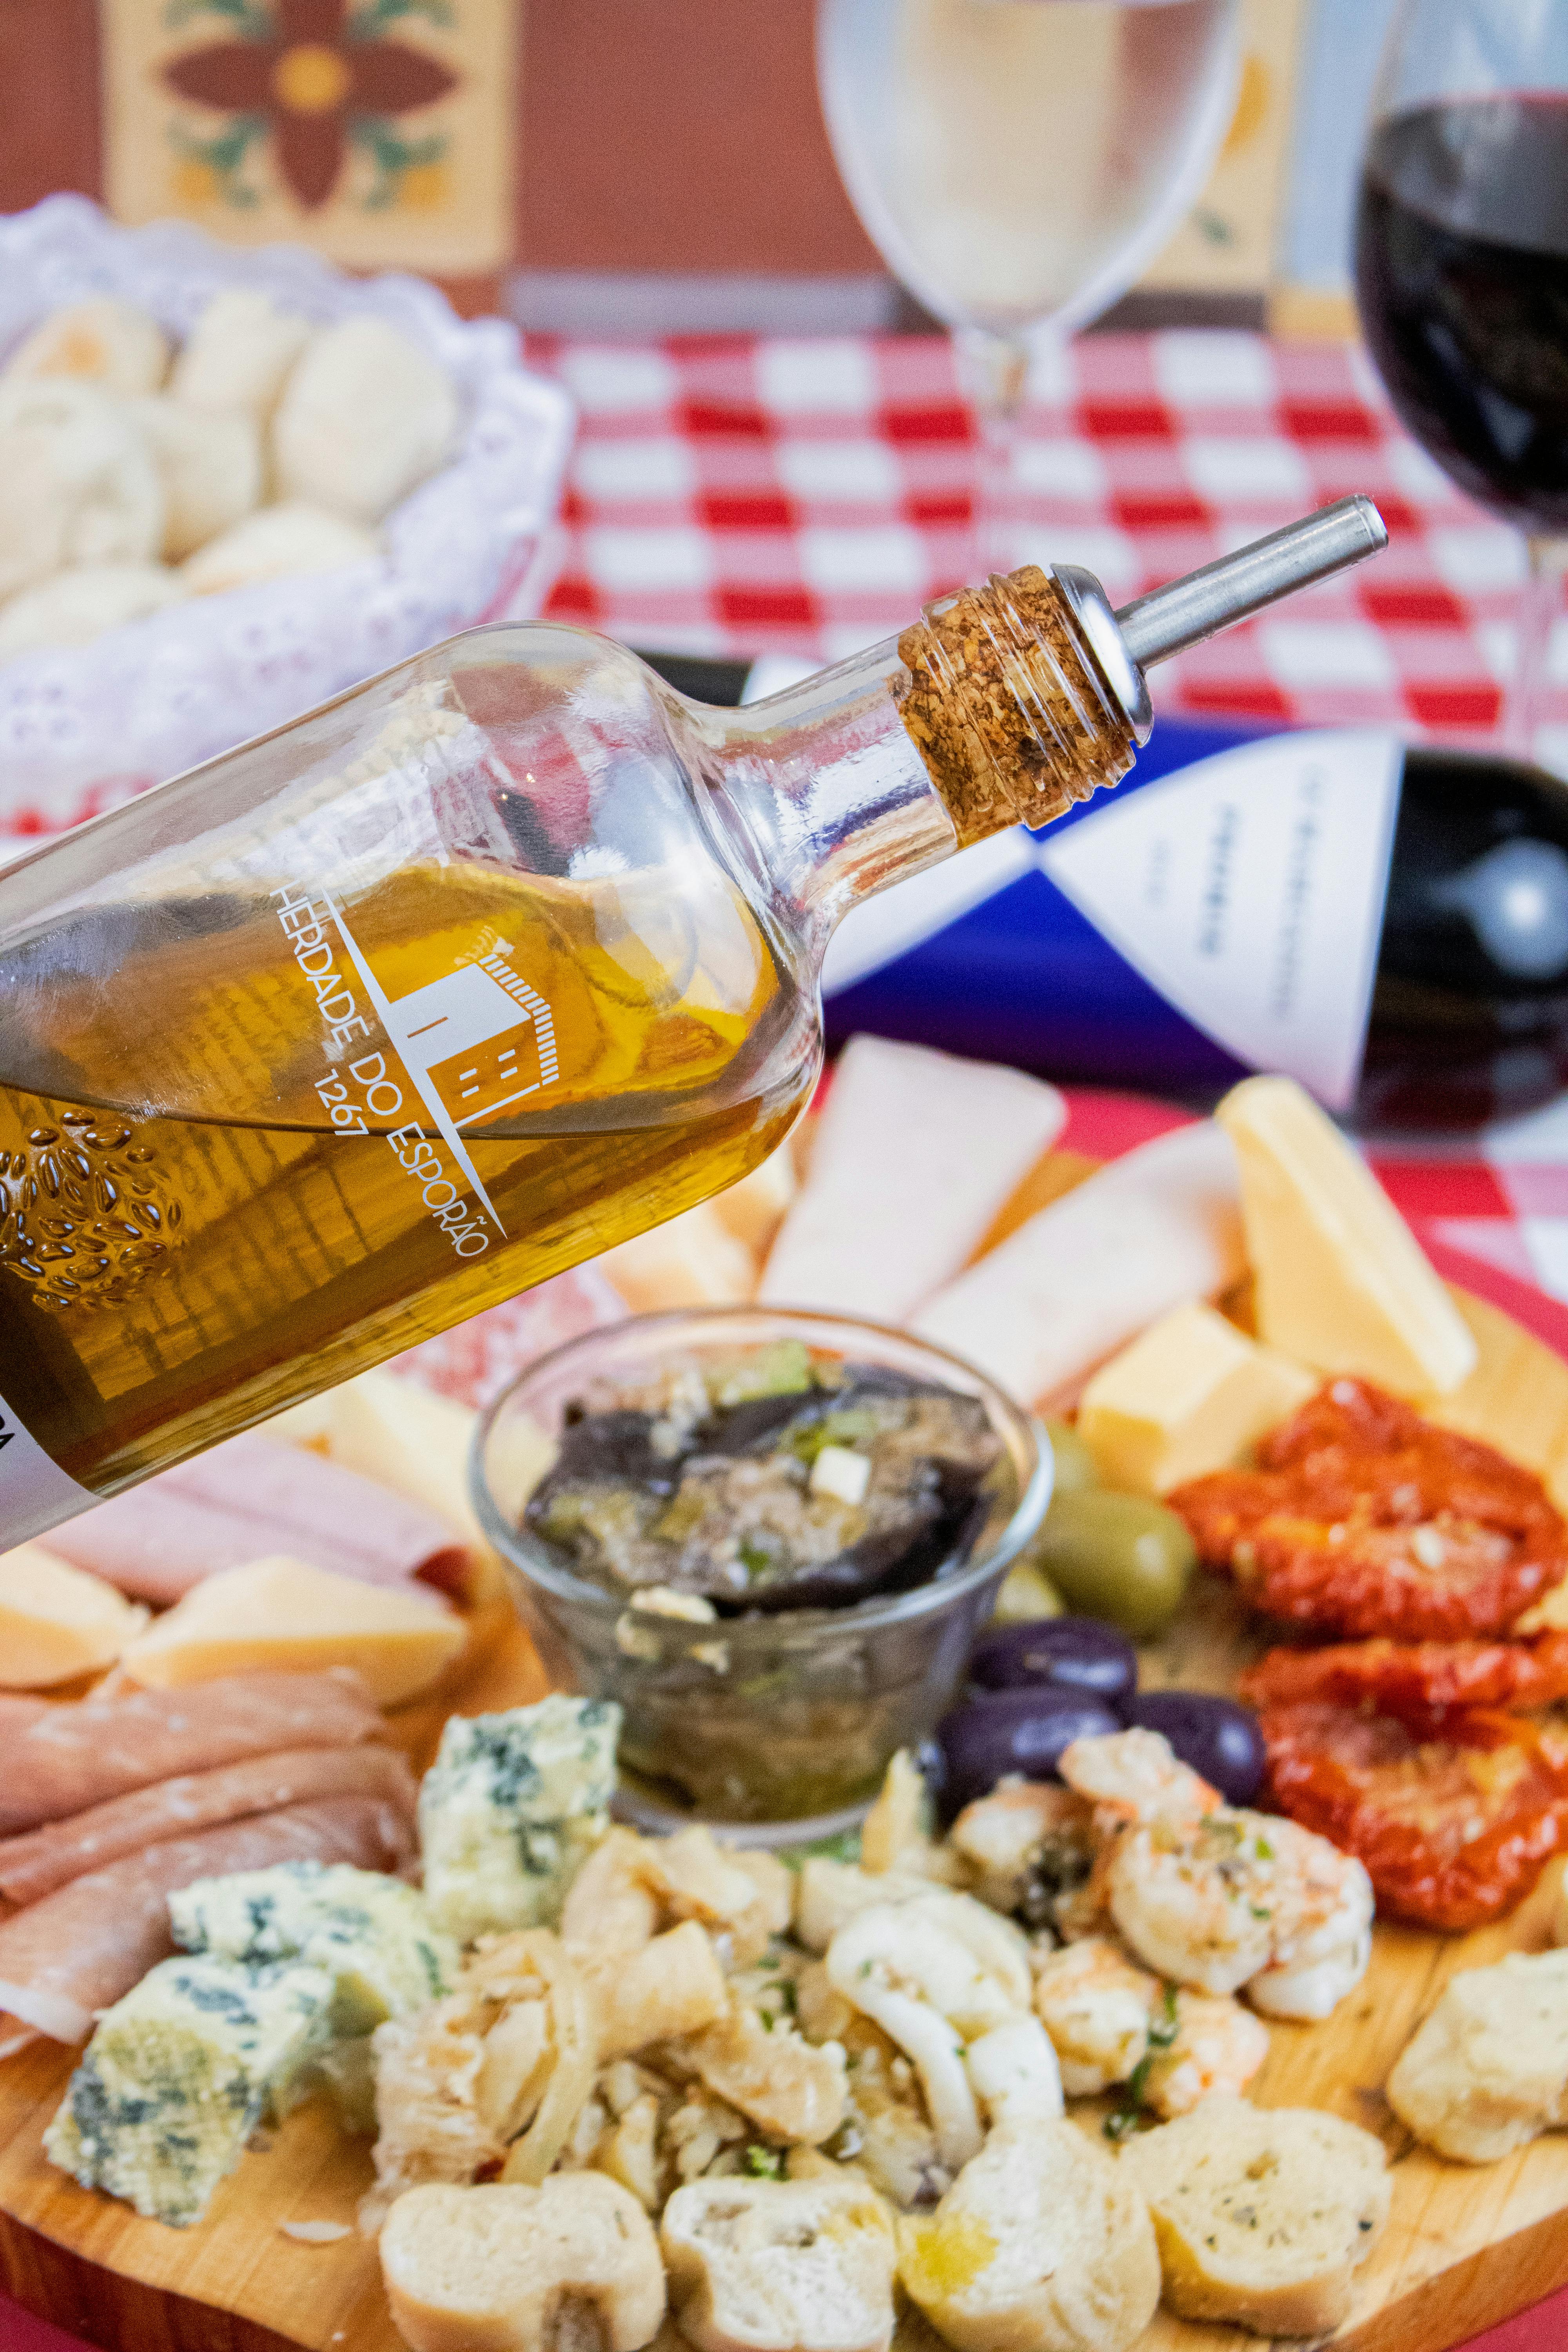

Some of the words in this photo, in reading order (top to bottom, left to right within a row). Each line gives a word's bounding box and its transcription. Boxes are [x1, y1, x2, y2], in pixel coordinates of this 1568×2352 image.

[270, 880, 370, 1049] HERDADE
[348, 1051, 403, 1116] DO
[386, 1121, 488, 1257] ESPORÃO
[314, 1068, 369, 1136] 1267
